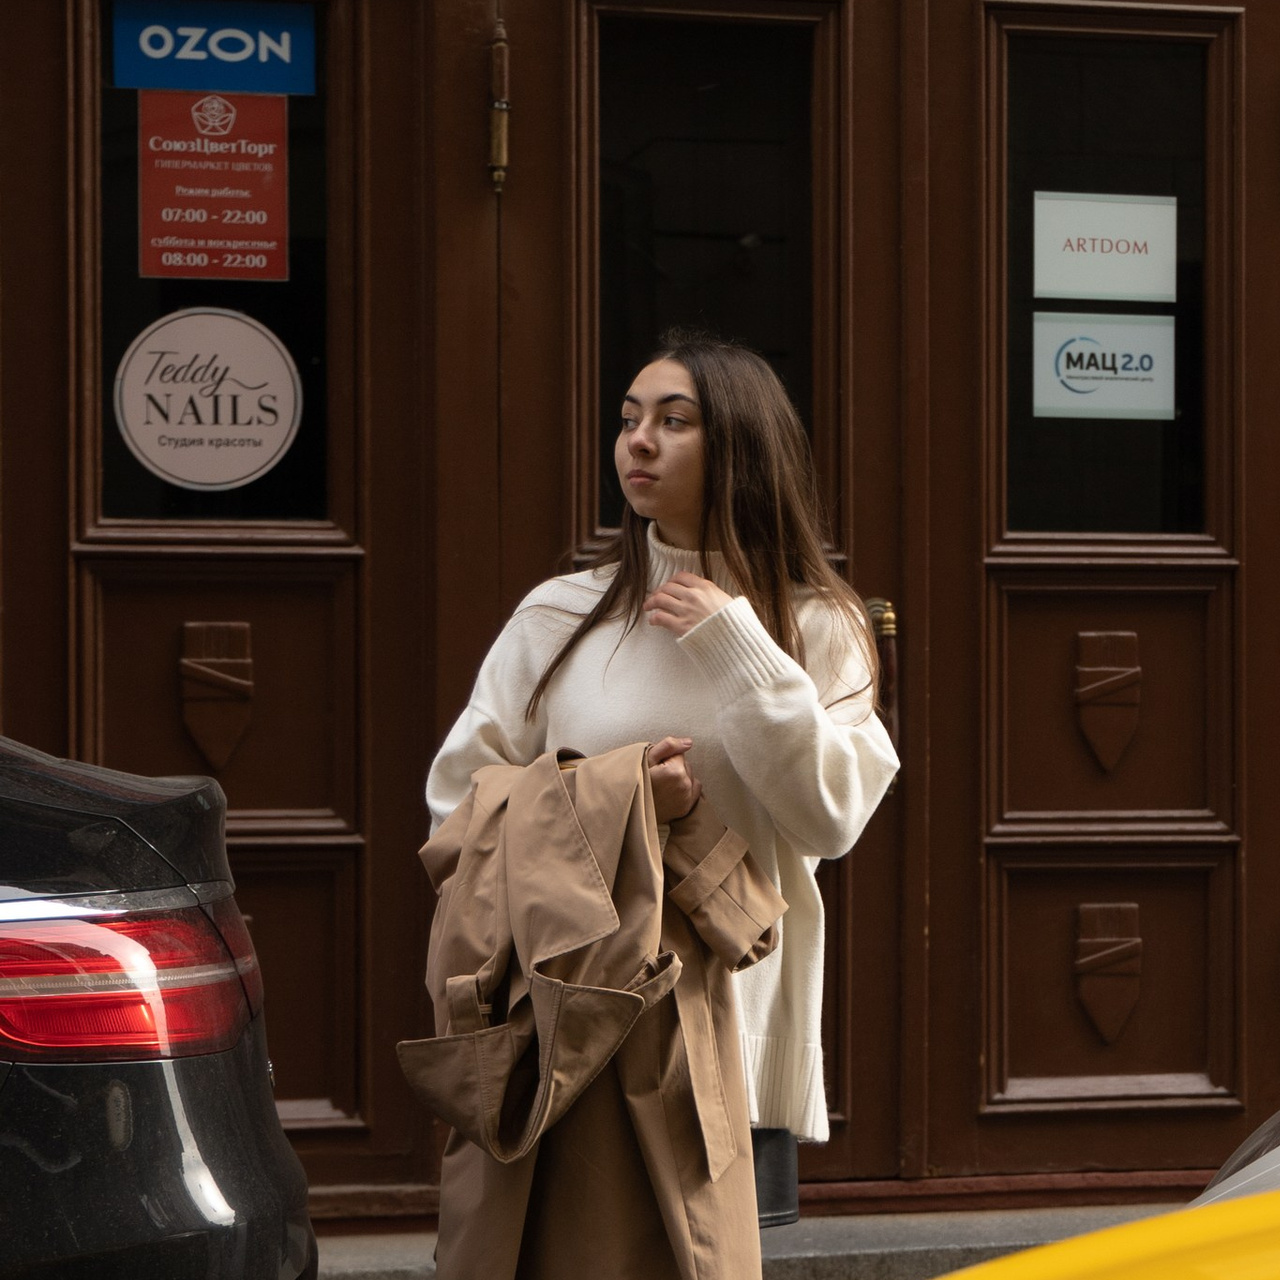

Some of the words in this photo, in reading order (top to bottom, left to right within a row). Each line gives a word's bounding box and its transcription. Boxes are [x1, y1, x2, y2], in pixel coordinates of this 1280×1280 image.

[139, 24, 292, 64] OZON
[148, 136, 277, 158] СоюзЦветТорг
[154, 159, 230, 171] ГИПЕРМАРКЕТ
[231, 161, 274, 173] ЦВЕТОВ
[161, 207, 208, 223] 07:00
[221, 209, 268, 224] 22:00
[1062, 237, 1149, 255] ARTDOM
[161, 252, 208, 267] 08:00
[222, 254, 268, 269] 22:00
[1066, 352, 1118, 375] МАЦ
[1121, 353, 1154, 371] 2.0
[144, 351, 269, 398] Teddy
[143, 393, 279, 426] NAILS
[158, 434, 204, 449] Студия
[208, 437, 263, 450] красоты
